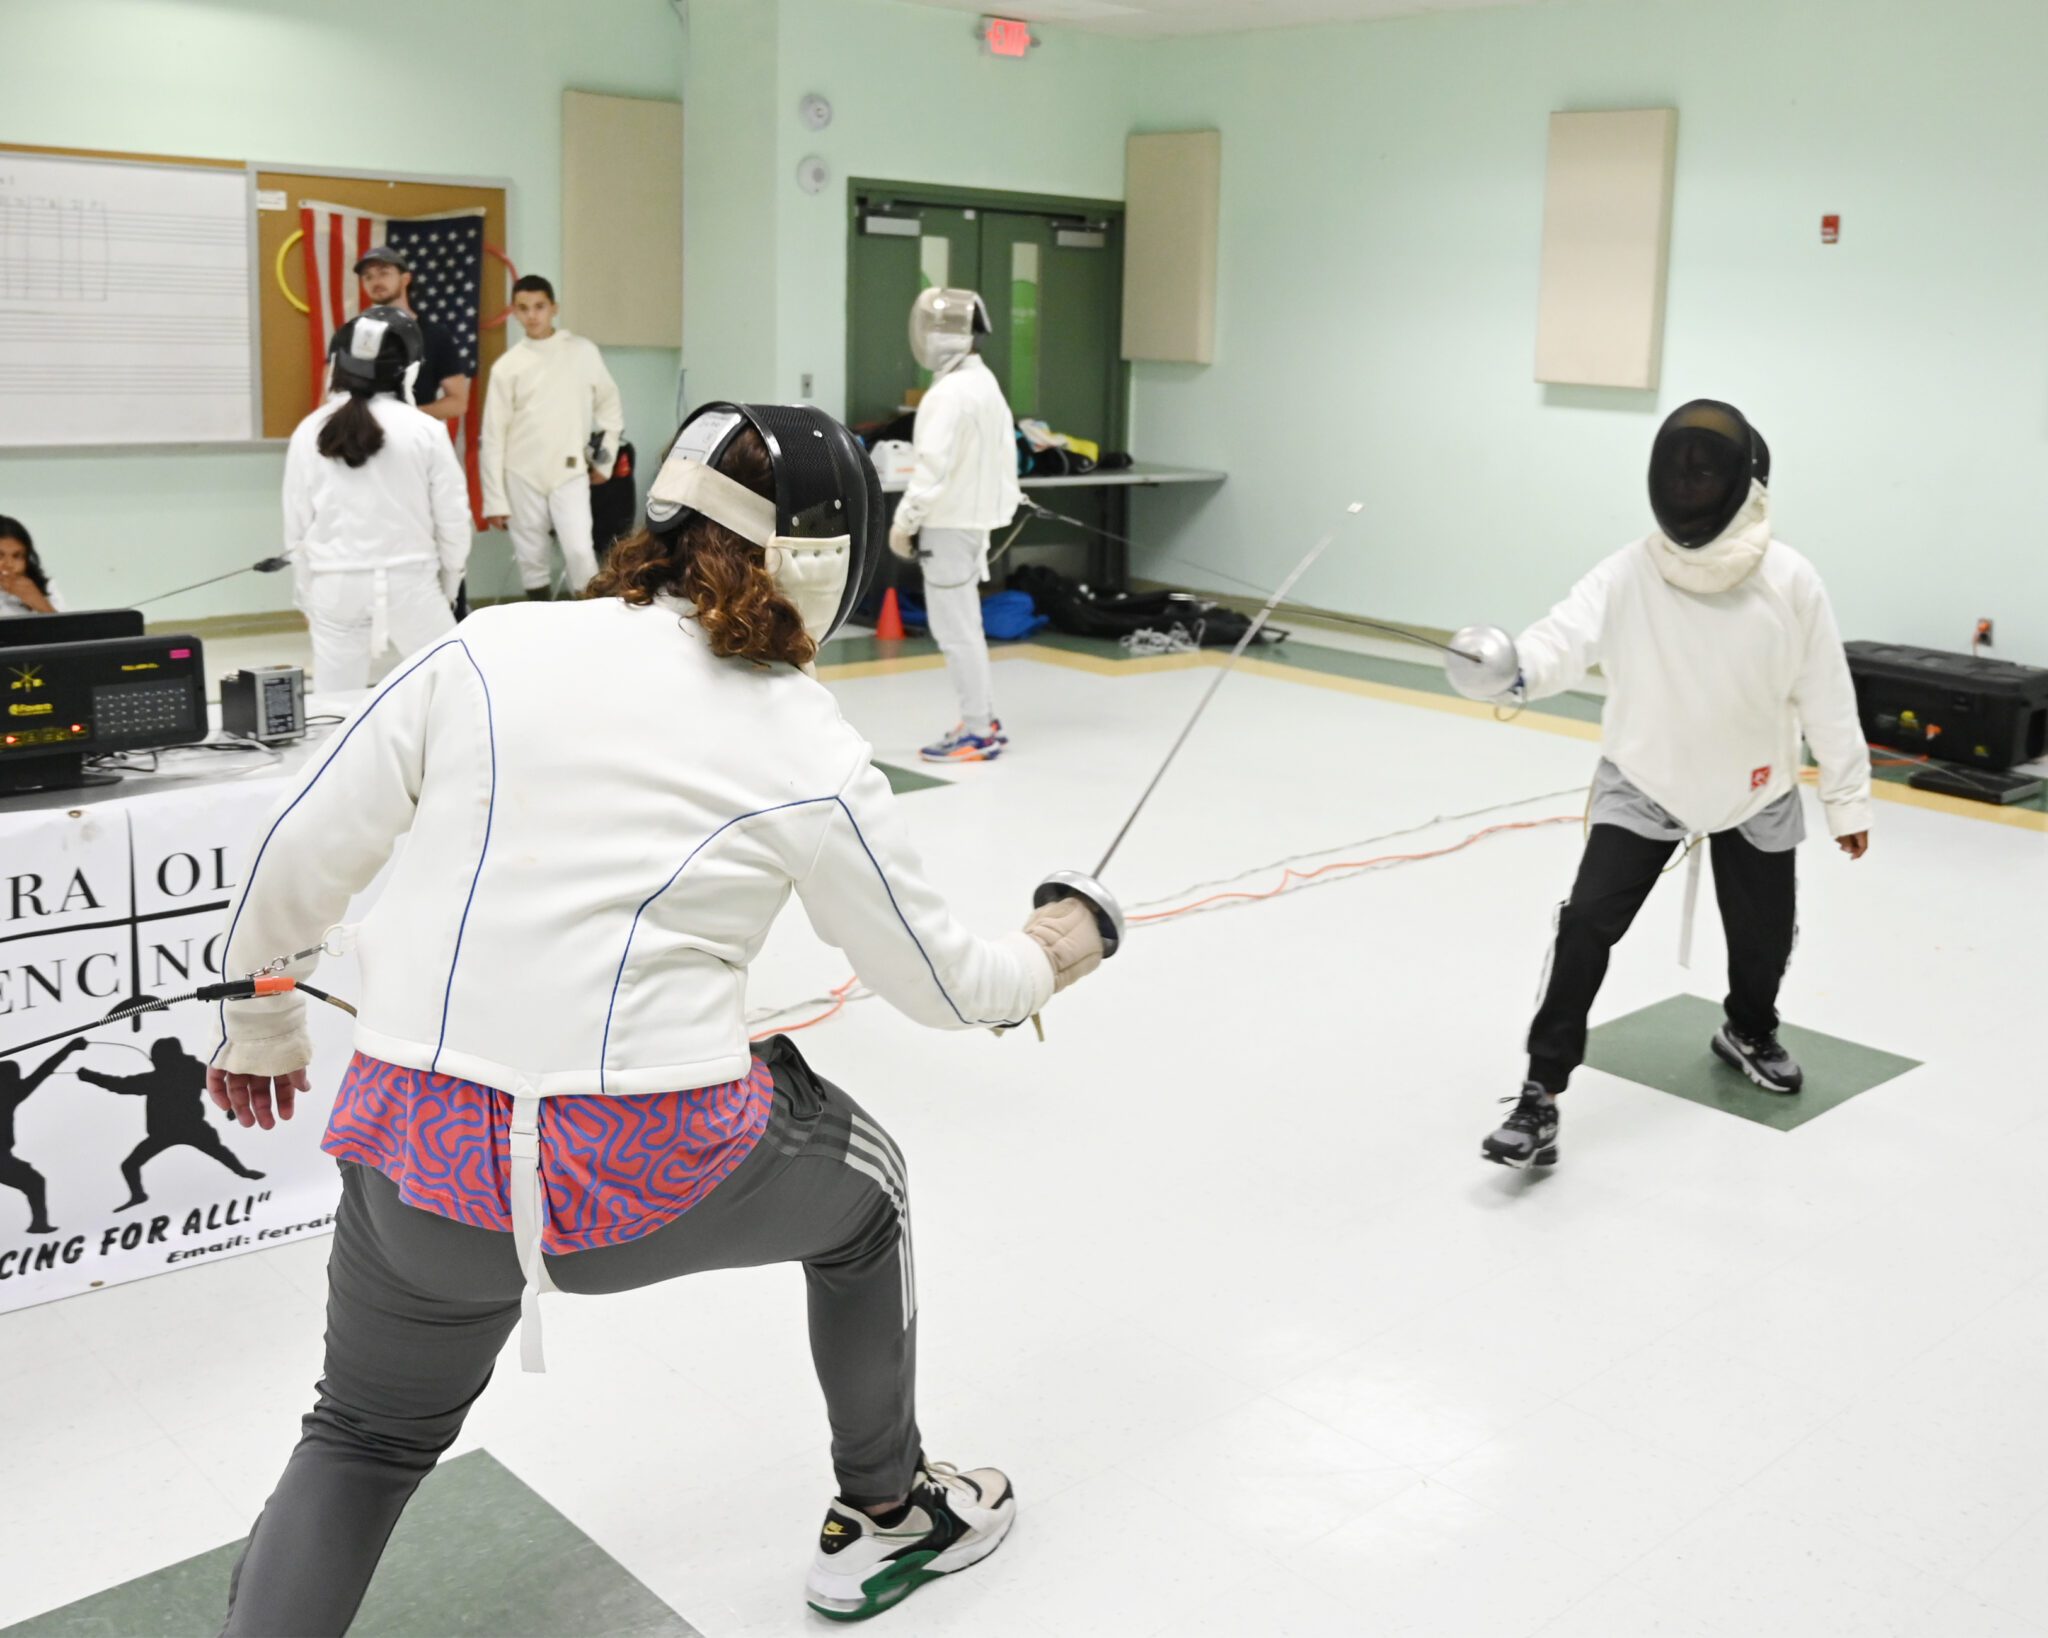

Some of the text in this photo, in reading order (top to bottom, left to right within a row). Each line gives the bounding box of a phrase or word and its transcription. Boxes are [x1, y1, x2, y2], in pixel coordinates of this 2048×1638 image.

[100, 1215, 170, 1256] FOR
[166, 1213, 337, 1263] Email: ferrai
